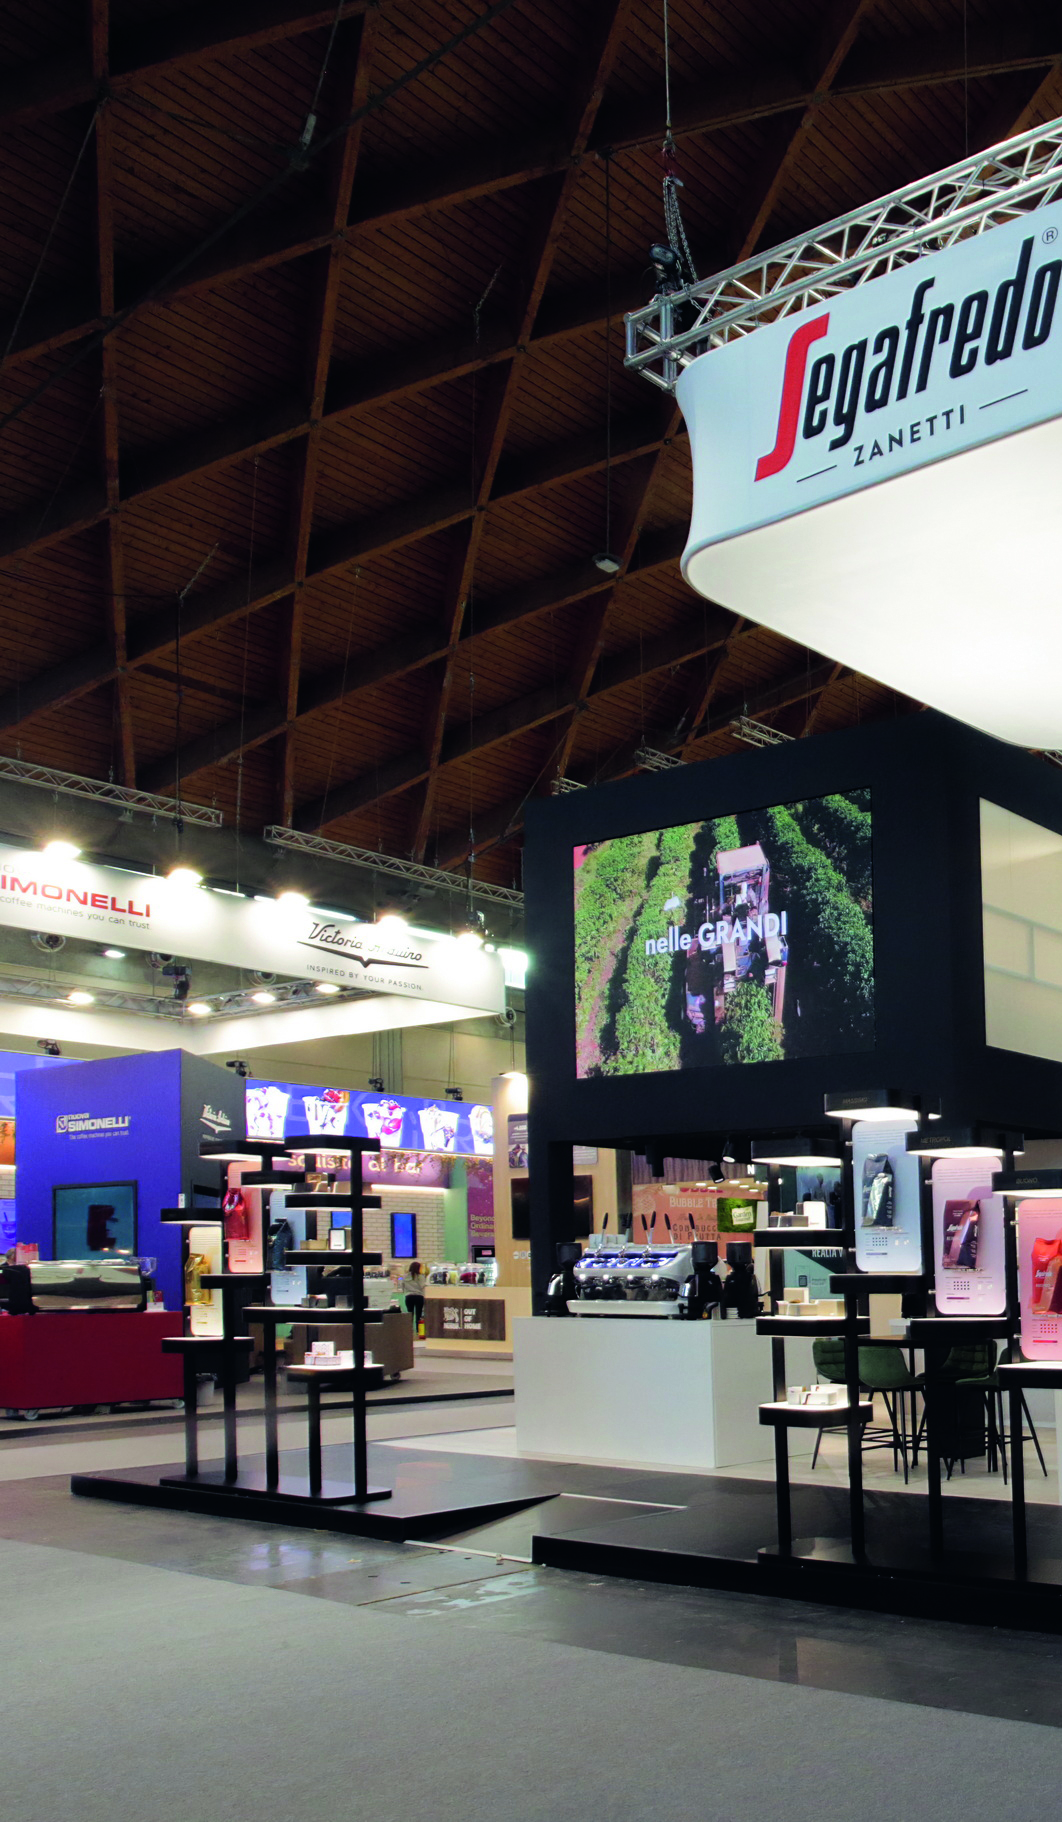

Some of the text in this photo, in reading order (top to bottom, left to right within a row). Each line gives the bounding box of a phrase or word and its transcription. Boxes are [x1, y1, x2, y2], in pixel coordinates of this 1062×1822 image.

[754, 235, 1062, 483] Segafredo
[853, 404, 965, 467] ZANETTI
[36, 902, 84, 917] machines
[87, 912, 105, 922] you
[108, 916, 125, 925] can
[308, 922, 363, 949] Victoria
[645, 910, 787, 955] nelle GRANDI
[306, 964, 345, 977] INSPIRED
[348, 971, 359, 979] BY
[363, 974, 385, 984] YOUR
[67, 1116, 129, 1132] SIMONELLI
[687, 1232, 722, 1241] FUTTA
